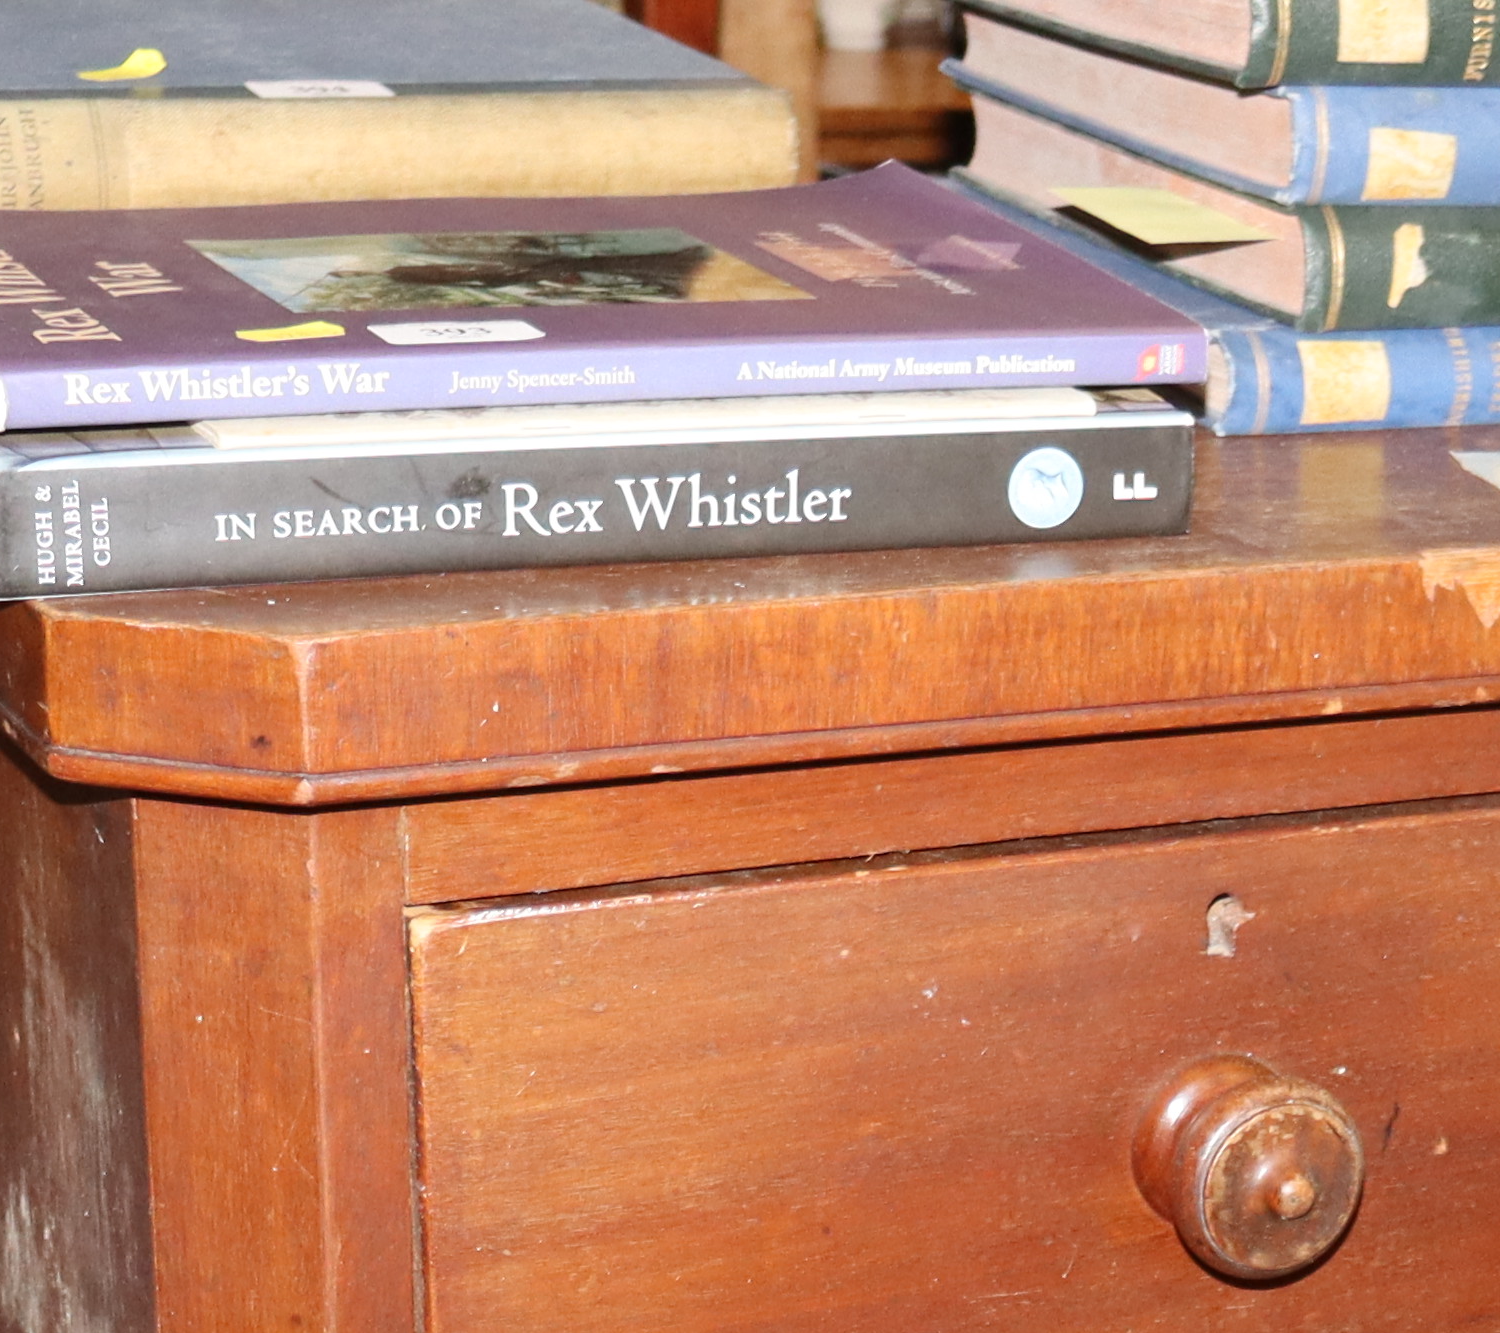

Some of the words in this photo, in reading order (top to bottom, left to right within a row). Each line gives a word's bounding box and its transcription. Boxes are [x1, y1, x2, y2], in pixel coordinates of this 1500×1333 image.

[19, 109, 45, 210] ANBRUGH
[0, 184, 18, 209] IR
[89, 261, 184, 297] War
[32, 308, 122, 344] Rex
[63, 373, 132, 405] Rex
[138, 366, 310, 402] Whistler's
[318, 363, 391, 395] War
[449, 371, 503, 394] Jenny
[507, 365, 636, 393] Spencer-Smith
[736, 362, 753, 381] A
[756, 359, 835, 379] National
[839, 359, 889, 382] Army
[894, 357, 971, 377] Museum
[975, 354, 1076, 374] Publication
[35, 484, 52, 502] &
[215, 512, 258, 542] IN
[272, 505, 419, 540] SEARCH
[436, 501, 484, 530] OF
[500, 480, 605, 538] Rex
[616, 470, 852, 533] Whistler
[35, 511, 56, 586] HUGH
[62, 479, 85, 588] MIRABEL
[90, 497, 112, 567] CECIL
